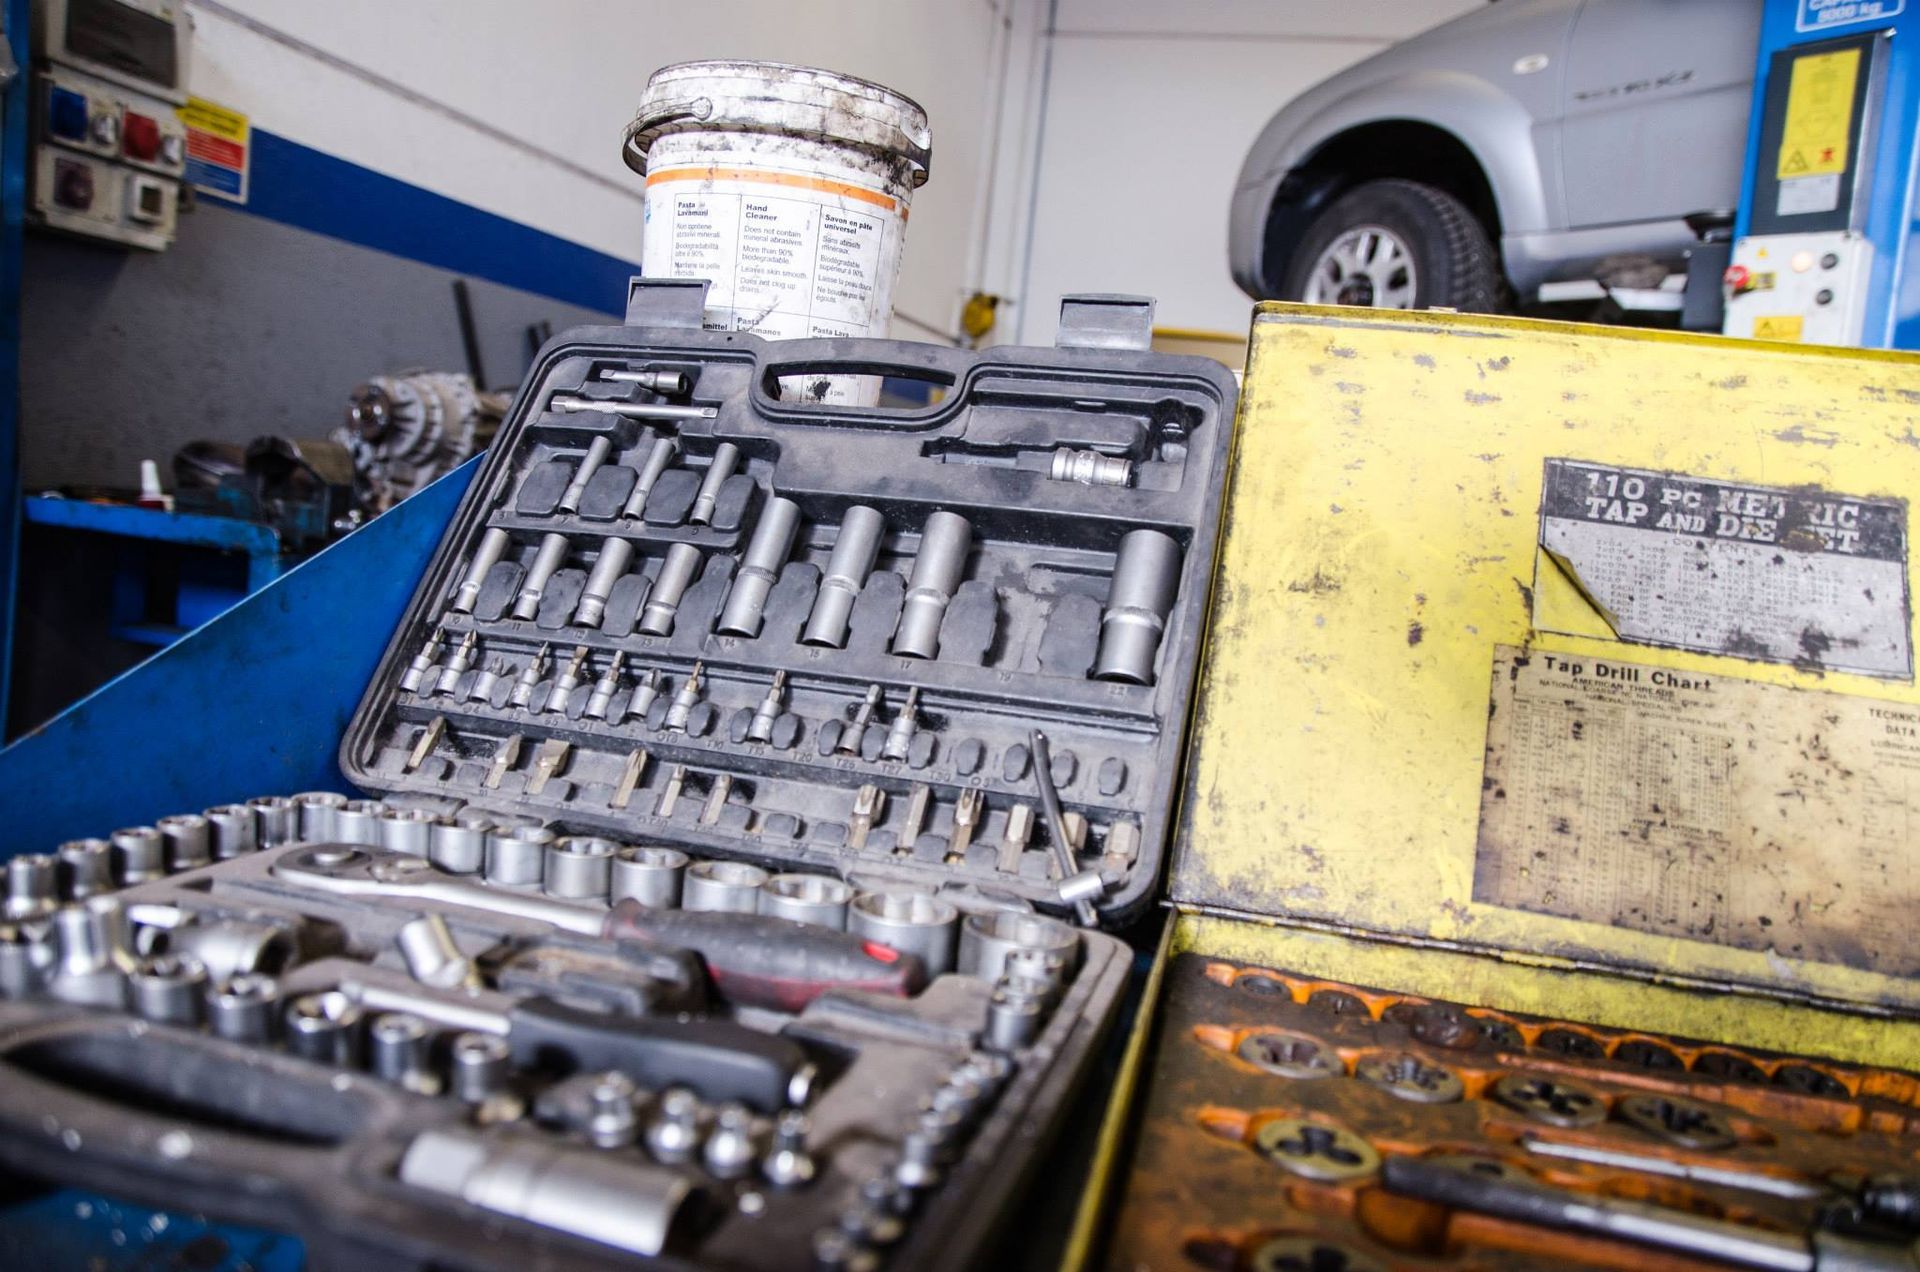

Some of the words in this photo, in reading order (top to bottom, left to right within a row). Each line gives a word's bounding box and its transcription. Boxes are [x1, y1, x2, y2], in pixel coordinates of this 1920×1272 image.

[678, 201, 696, 209] Pasta
[745, 203, 768, 212] Hand
[745, 211, 778, 221] Cleaner
[825, 213, 848, 225] Savon
[849, 219, 858, 227] en
[858, 221, 873, 231] pâte
[743, 224, 762, 233] Does
[763, 227, 775, 235] not
[776, 228, 802, 238] contain
[824, 222, 857, 234] universel
[742, 244, 760, 253] More
[761, 247, 777, 255] than
[778, 248, 794, 258] 90%
[739, 276, 758, 285] Does
[771, 280, 786, 290] clog
[787, 283, 796, 291] up
[737, 316, 760, 326] Pasta
[812, 325, 833, 336] Pasta
[1585, 471, 1646, 500] 110
[1660, 487, 1703, 508] PC
[1585, 495, 1649, 524] TAP
[1656, 512, 1706, 533] AND
[1544, 656, 1583, 676] Tap
[1595, 663, 1639, 682] Drill
[1651, 671, 1712, 690] Chart
[1572, 677, 1624, 689] AMERICAN
[1869, 708, 1920, 722] TECHNIC
[1885, 724, 1917, 737] DATA
